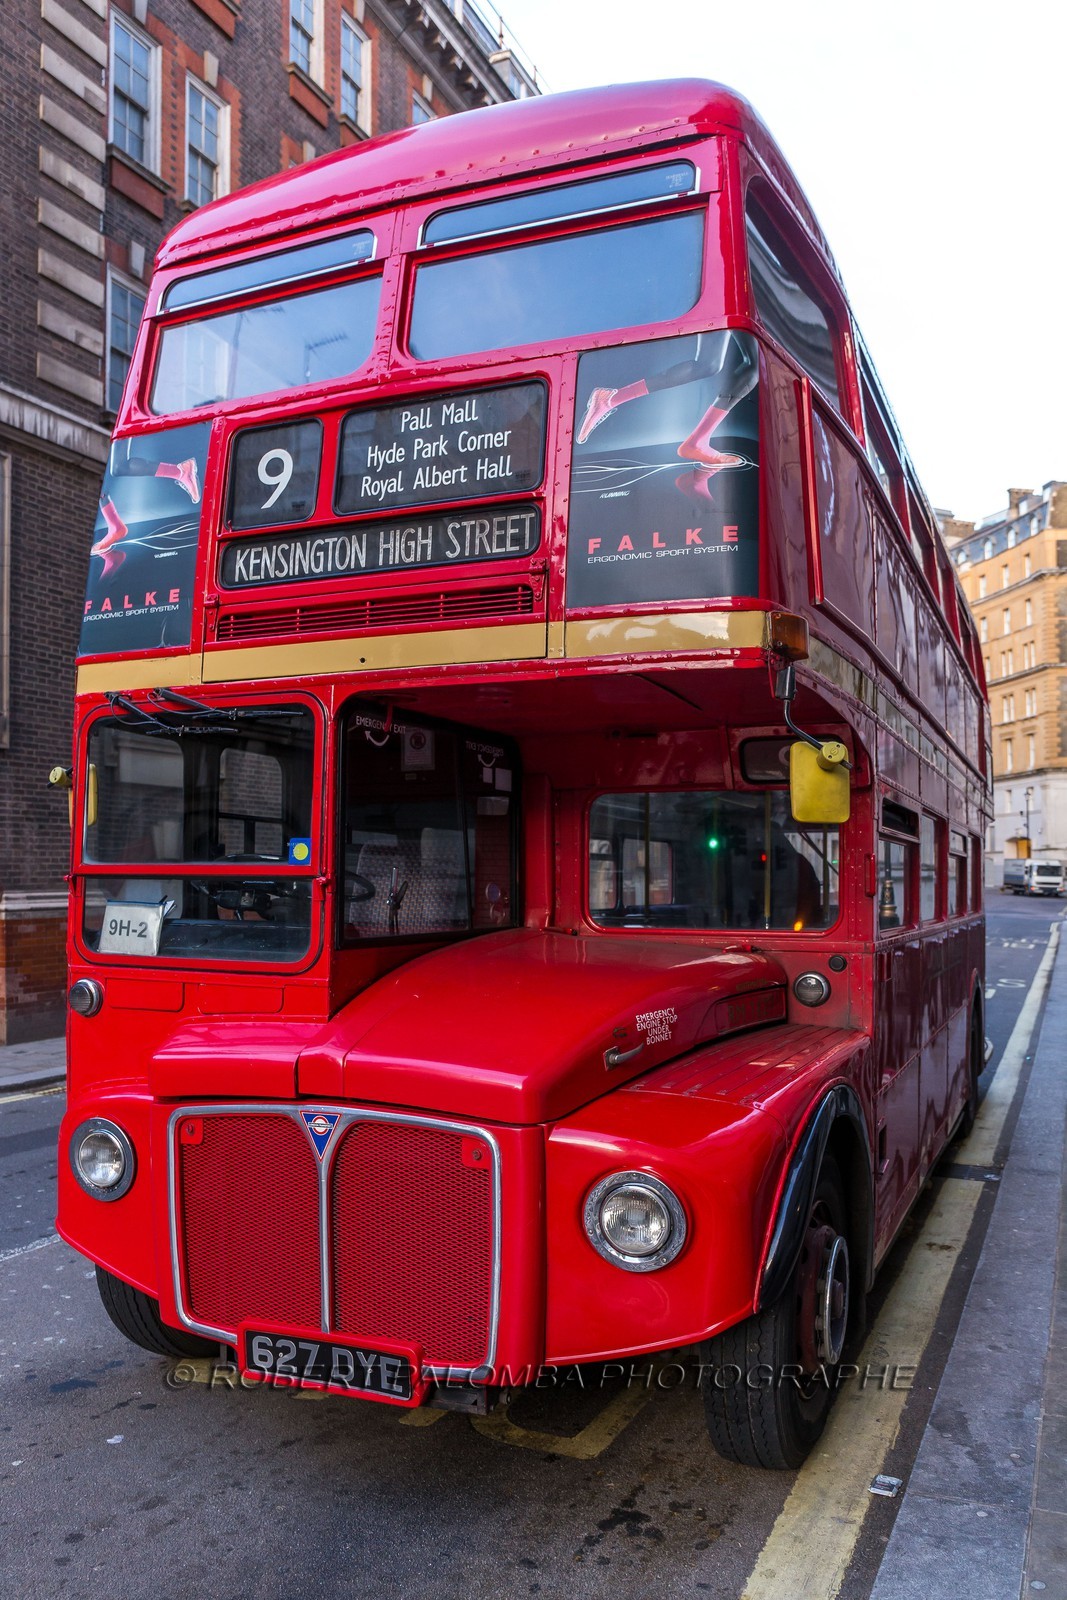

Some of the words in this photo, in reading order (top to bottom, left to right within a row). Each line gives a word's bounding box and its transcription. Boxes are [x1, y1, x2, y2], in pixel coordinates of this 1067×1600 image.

[401, 406, 433, 433] Pall
[441, 399, 479, 426] Mall
[367, 442, 405, 472] Hyde
[413, 435, 448, 460] Park
[458, 430, 512, 453] Corner
[257, 448, 294, 510] 9
[360, 470, 404, 501] Royal
[412, 465, 468, 490] Albert
[476, 454, 513, 481] Hall
[234, 533, 367, 582] KENSINGTON
[379, 525, 433, 566] HIGH
[445, 513, 535, 559] STREET
[587, 525, 739, 555] FALKE
[587, 551, 652, 564] ERGONOMIC
[655, 548, 691, 558] SPORT
[693, 544, 739, 555] SYSTEM
[83, 611, 124, 622] ERGONOMIC
[125, 607, 148, 617] SPORT
[149, 604, 179, 614] SYSTEM
[84, 588, 180, 615] FALKE
[356, 715, 393, 733] EMERGENY
[393, 723, 406, 734] EXIT
[108, 918, 149, 938] 9H-2
[635, 1007, 675, 1023] EMERGENCY
[636, 1017, 662, 1032] ENGINE
[662, 1014, 678, 1025] STOP
[646, 1031, 673, 1046] BONNET
[647, 1024, 670, 1037] UNDER
[251, 1335, 320, 1377] 627
[331, 1346, 403, 1393] DYE
